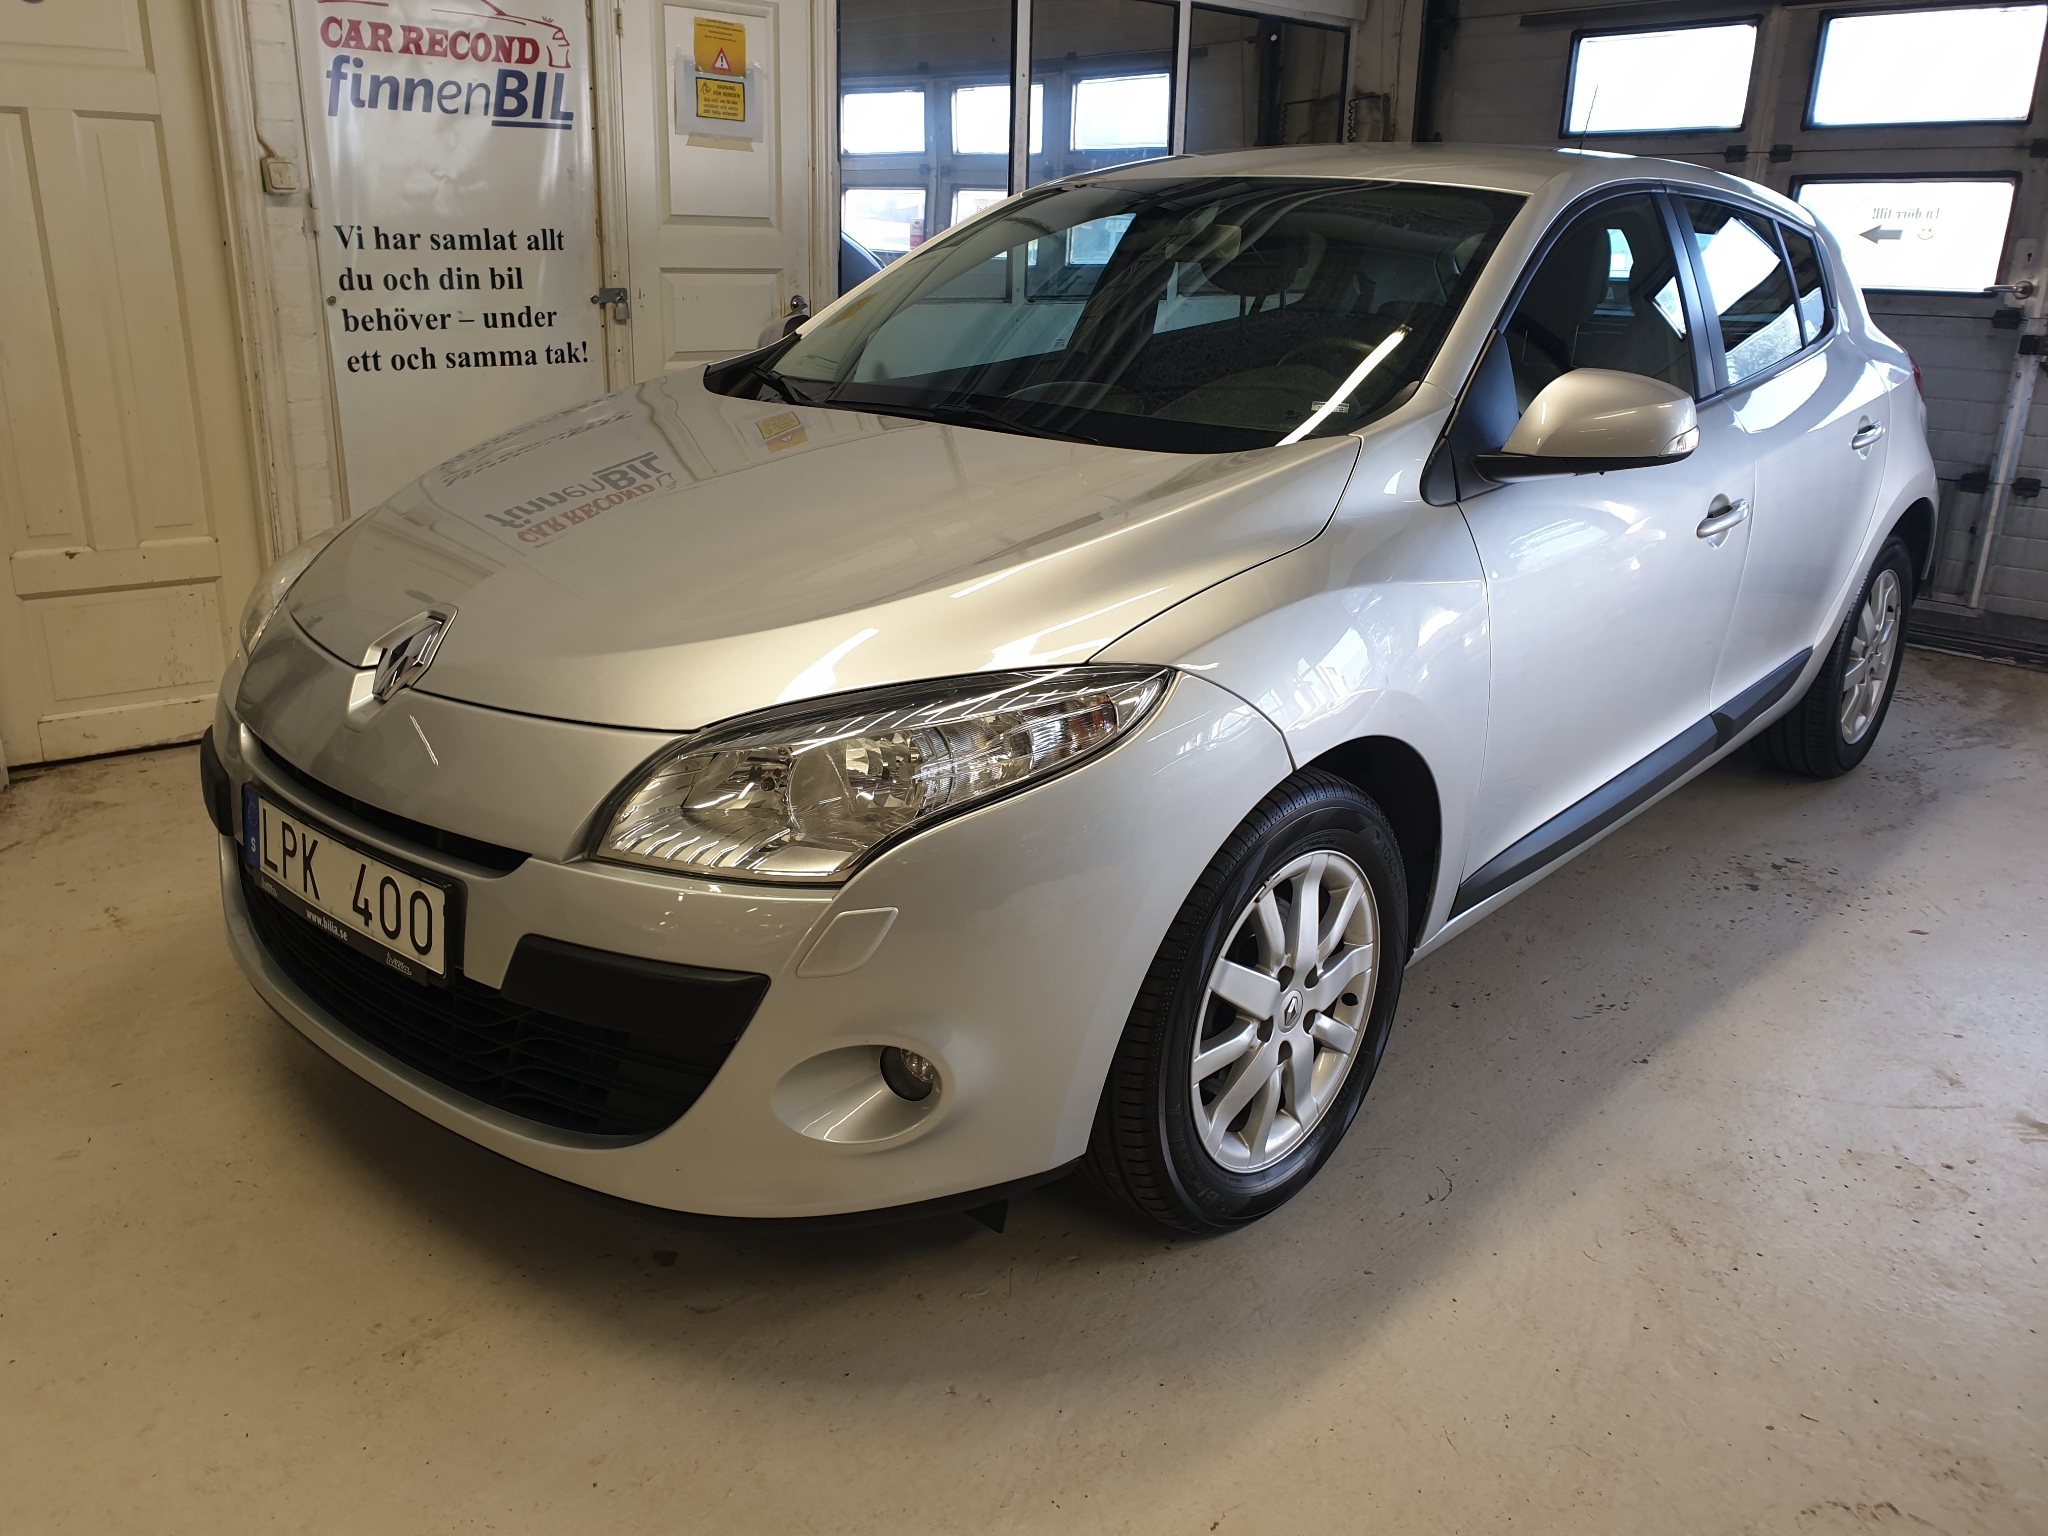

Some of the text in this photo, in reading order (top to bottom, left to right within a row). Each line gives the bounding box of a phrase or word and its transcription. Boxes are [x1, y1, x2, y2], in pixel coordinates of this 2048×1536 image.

[320, 15, 540, 65] CAR RECOND
[326, 54, 574, 122] finnenBIL
[333, 225, 565, 251] Vi har samlat allt
[338, 266, 524, 291] du och din bil
[340, 307, 452, 332] behöver
[482, 305, 557, 329] under
[346, 341, 588, 373] ett och samma tak!
[250, 837, 257, 852] S
[262, 807, 432, 956] LPK 400
[305, 909, 348, 942] www.bilia.se
